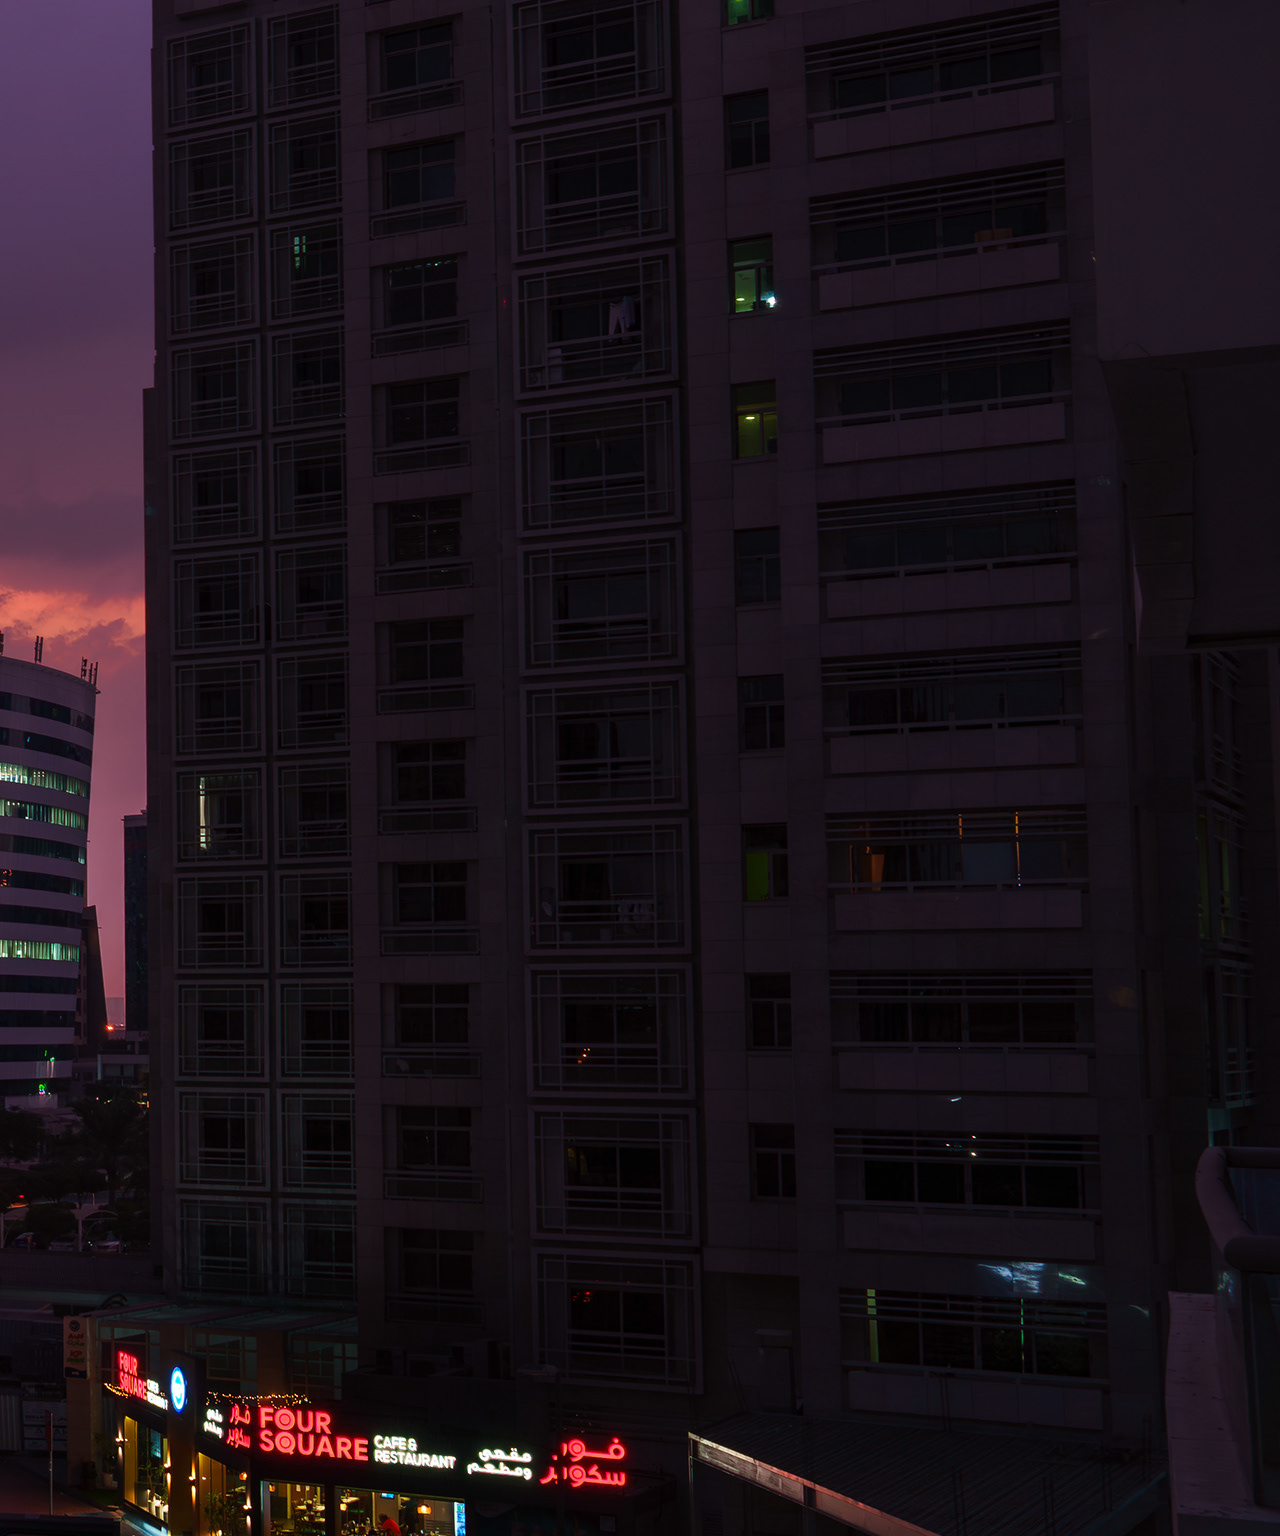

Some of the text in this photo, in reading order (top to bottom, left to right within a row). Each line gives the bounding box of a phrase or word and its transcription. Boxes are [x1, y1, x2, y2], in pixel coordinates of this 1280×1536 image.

[119, 1350, 138, 1376] FOUR
[120, 1370, 147, 1401] SQUARE
[258, 1406, 332, 1435] FOUR
[258, 1429, 370, 1462] SQUARE
[373, 1434, 418, 1452] CAFE &
[373, 1448, 457, 1470] RESTAURANT
